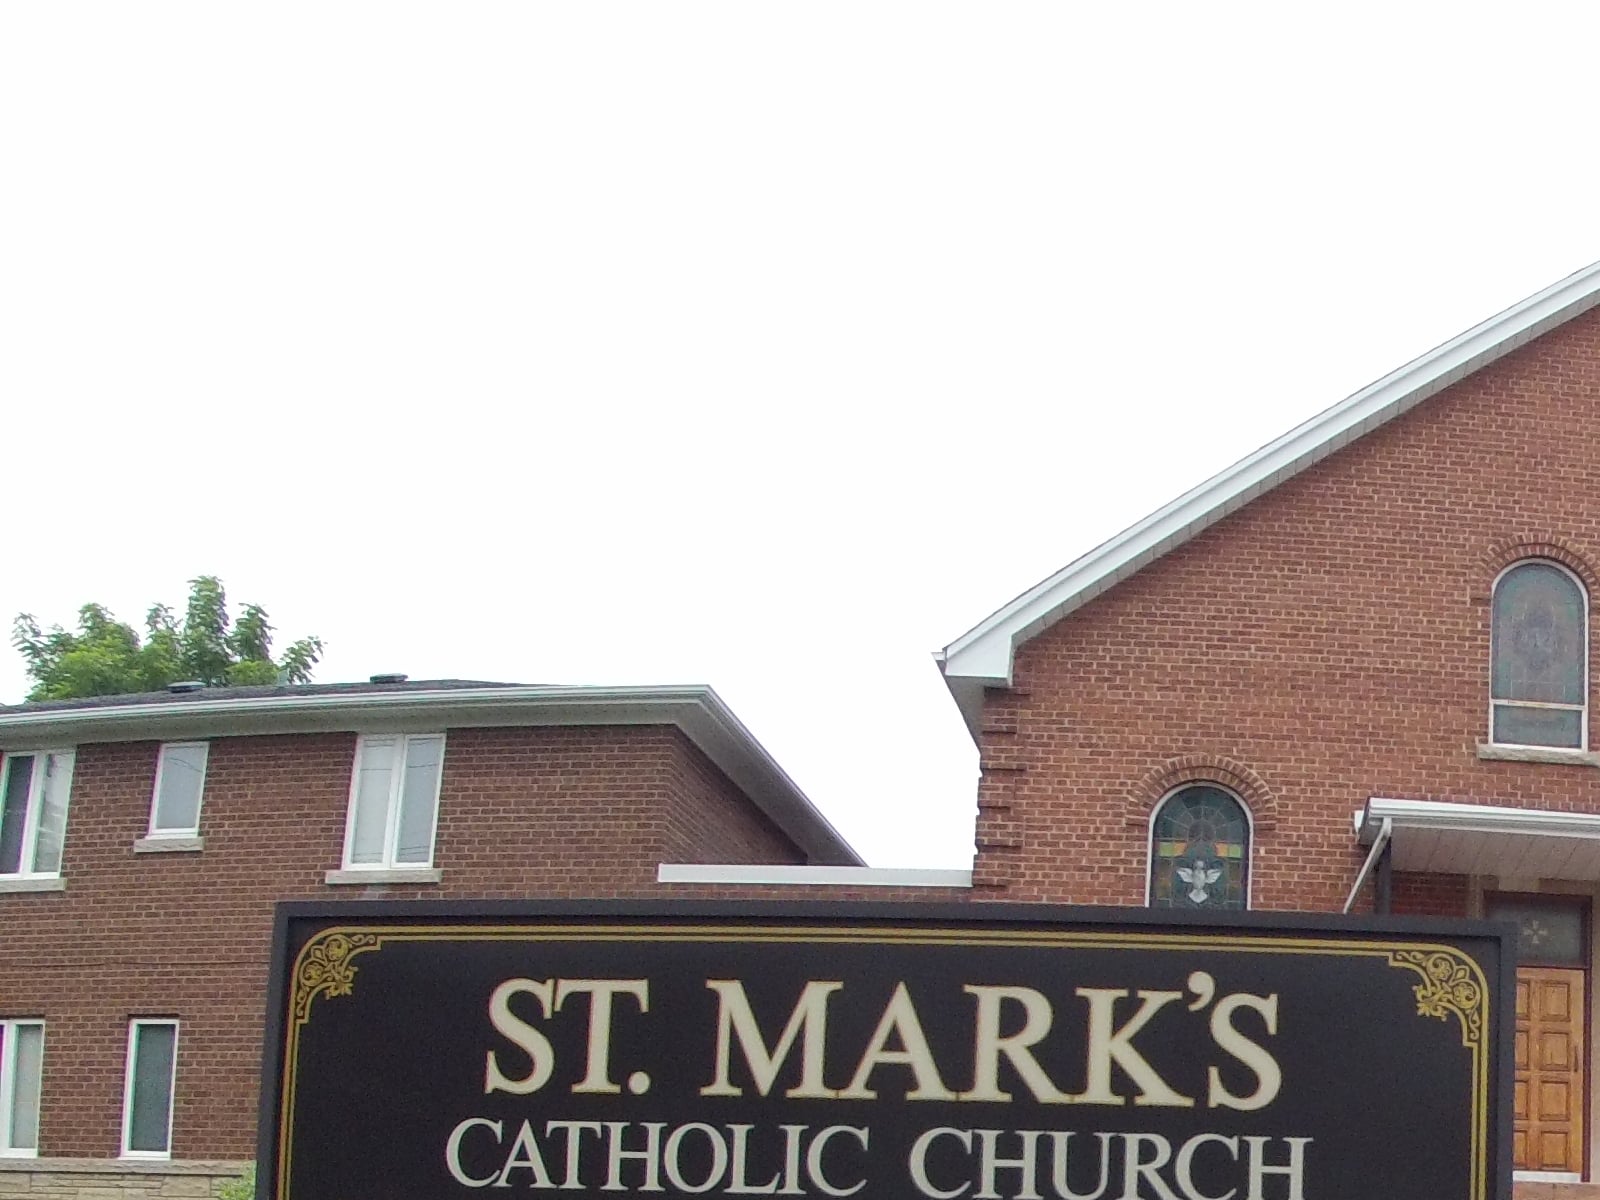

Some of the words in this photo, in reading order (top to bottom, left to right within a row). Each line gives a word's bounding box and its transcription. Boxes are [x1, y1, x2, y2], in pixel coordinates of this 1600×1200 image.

[485, 978, 650, 1095] ST.
[699, 971, 1282, 1111] MARK'S
[445, 1117, 869, 1197] CATHOLIC
